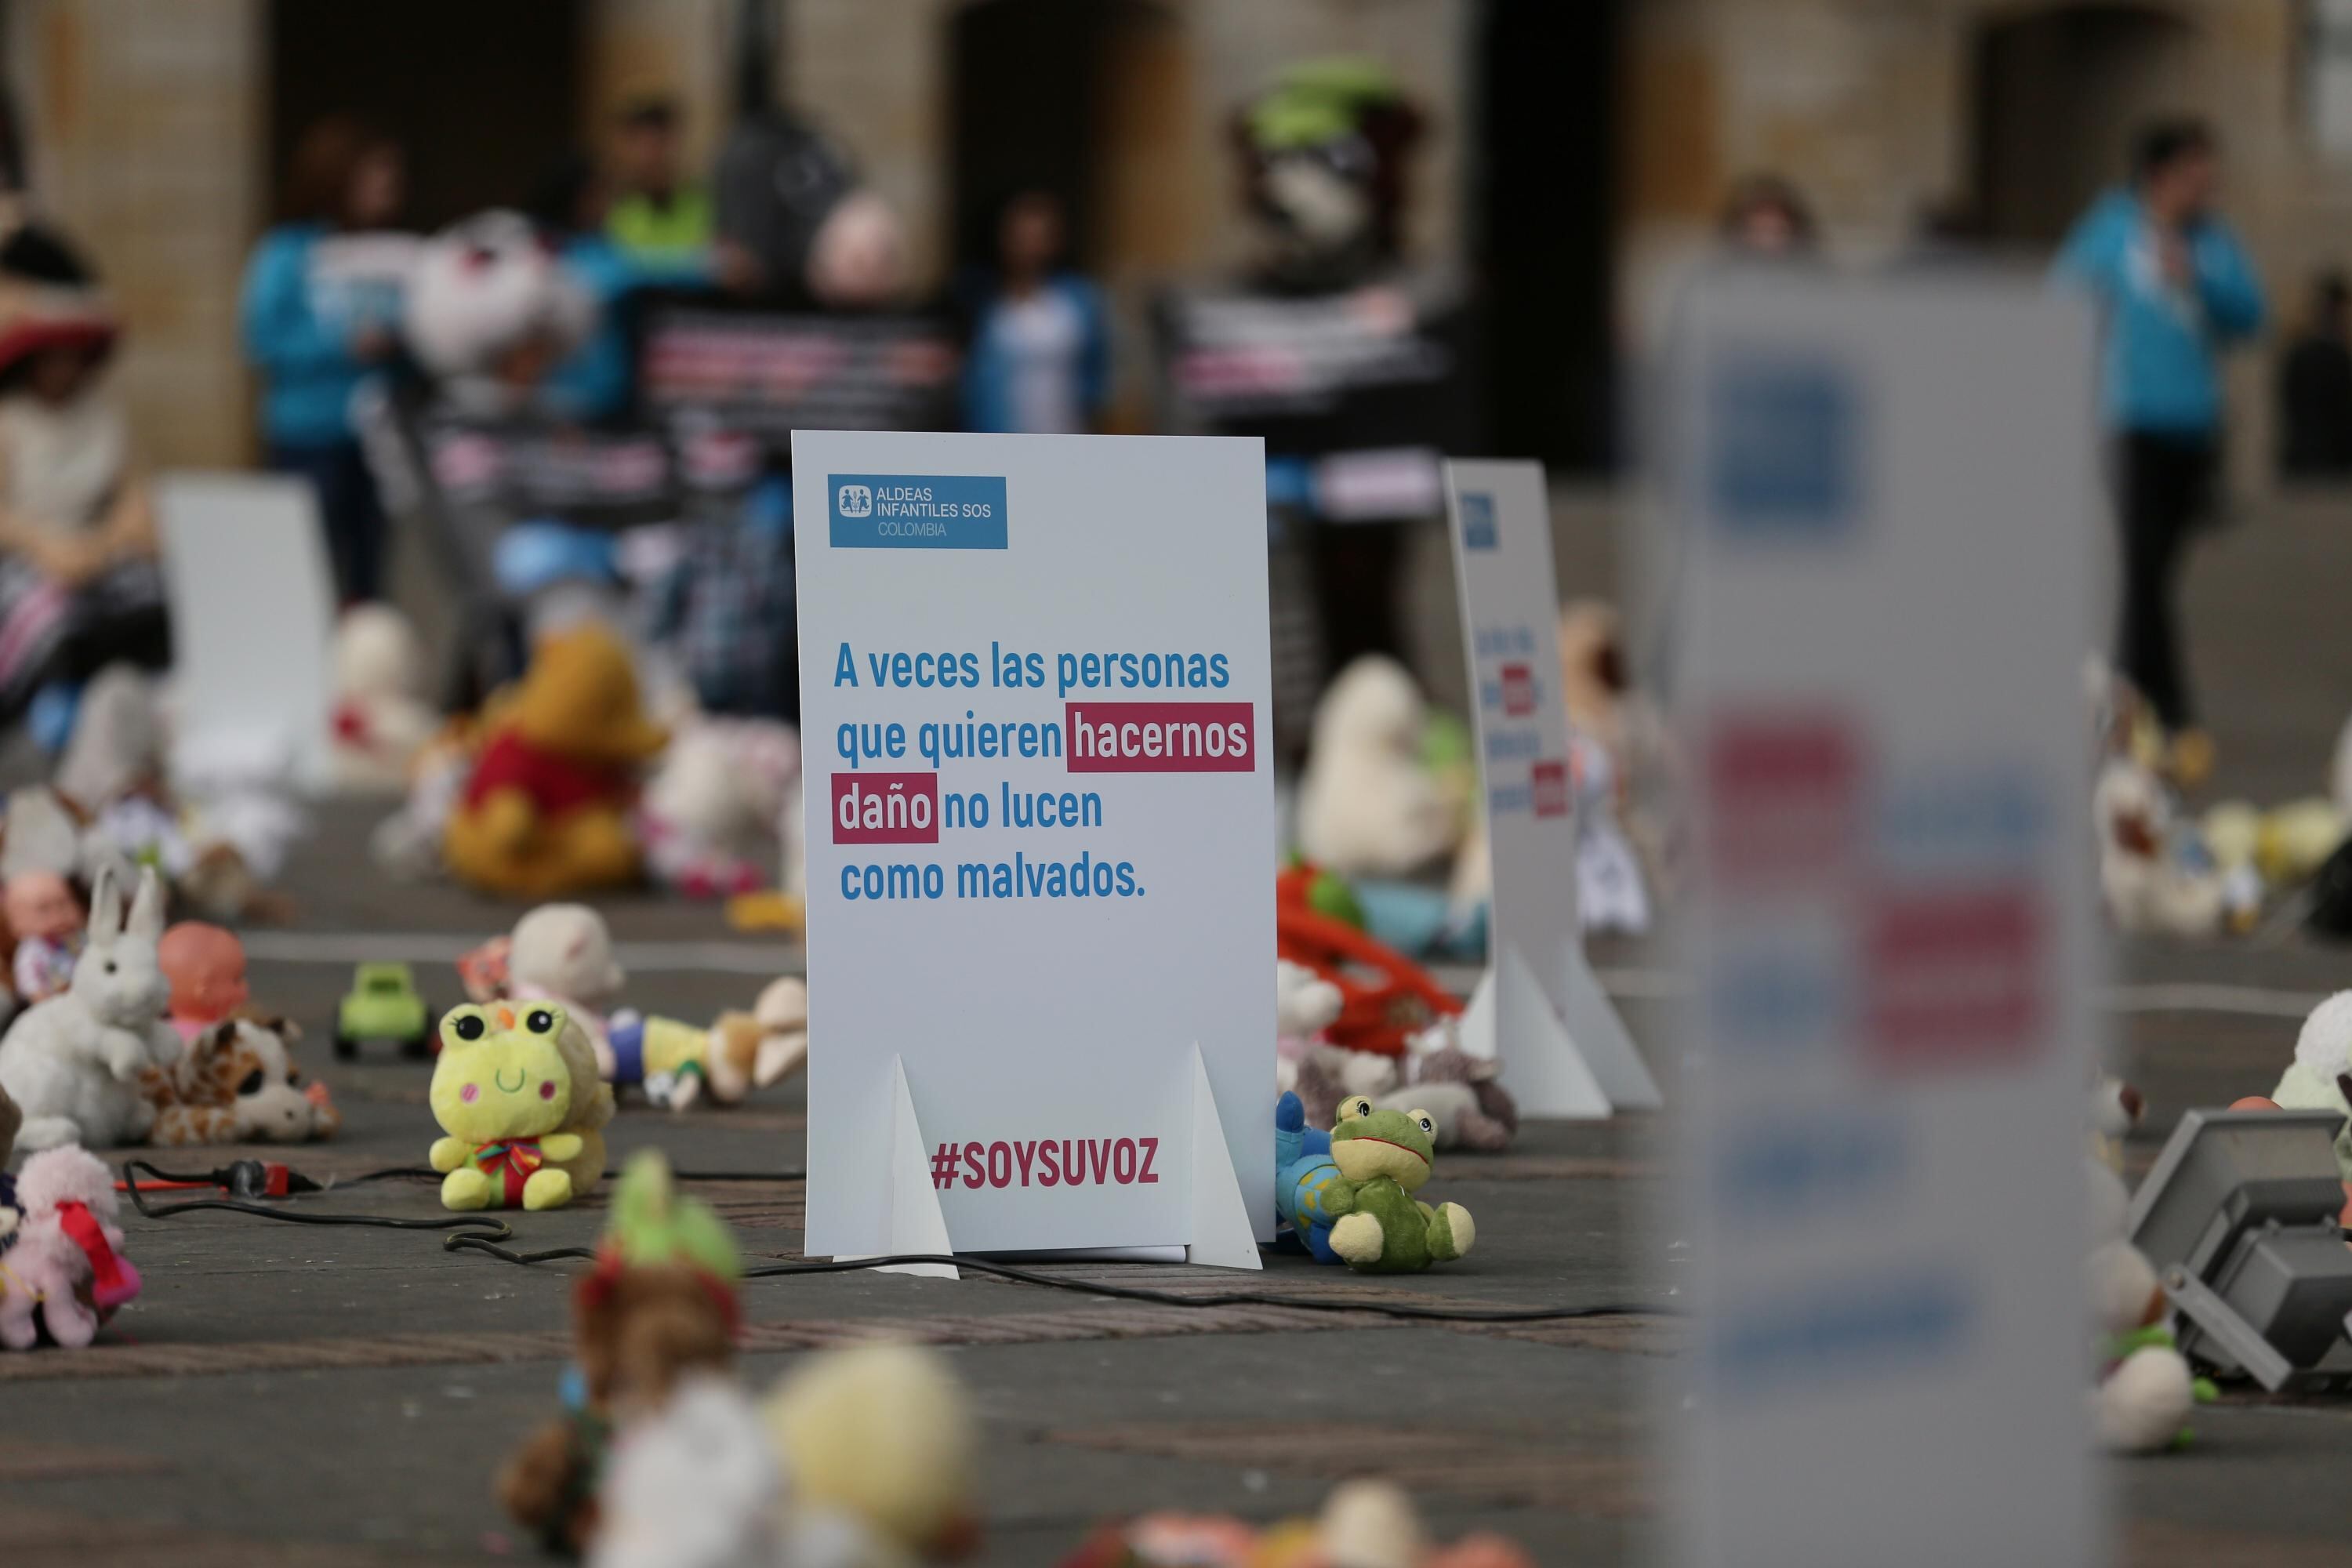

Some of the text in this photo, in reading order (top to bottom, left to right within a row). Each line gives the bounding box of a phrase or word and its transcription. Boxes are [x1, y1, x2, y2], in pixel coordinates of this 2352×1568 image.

[877, 487, 932, 502] ALDEAS
[877, 503, 992, 518] INFANTILES SOS
[877, 521, 947, 537] COLOMBIA
[833, 641, 1230, 699] A veces las personas
[836, 709, 1248, 771] que quieren hacernos
[838, 780, 1103, 830] daño no lucen
[840, 850, 1147, 901] como malvados.
[931, 1138, 1160, 1189] #SOYSUVOZ
